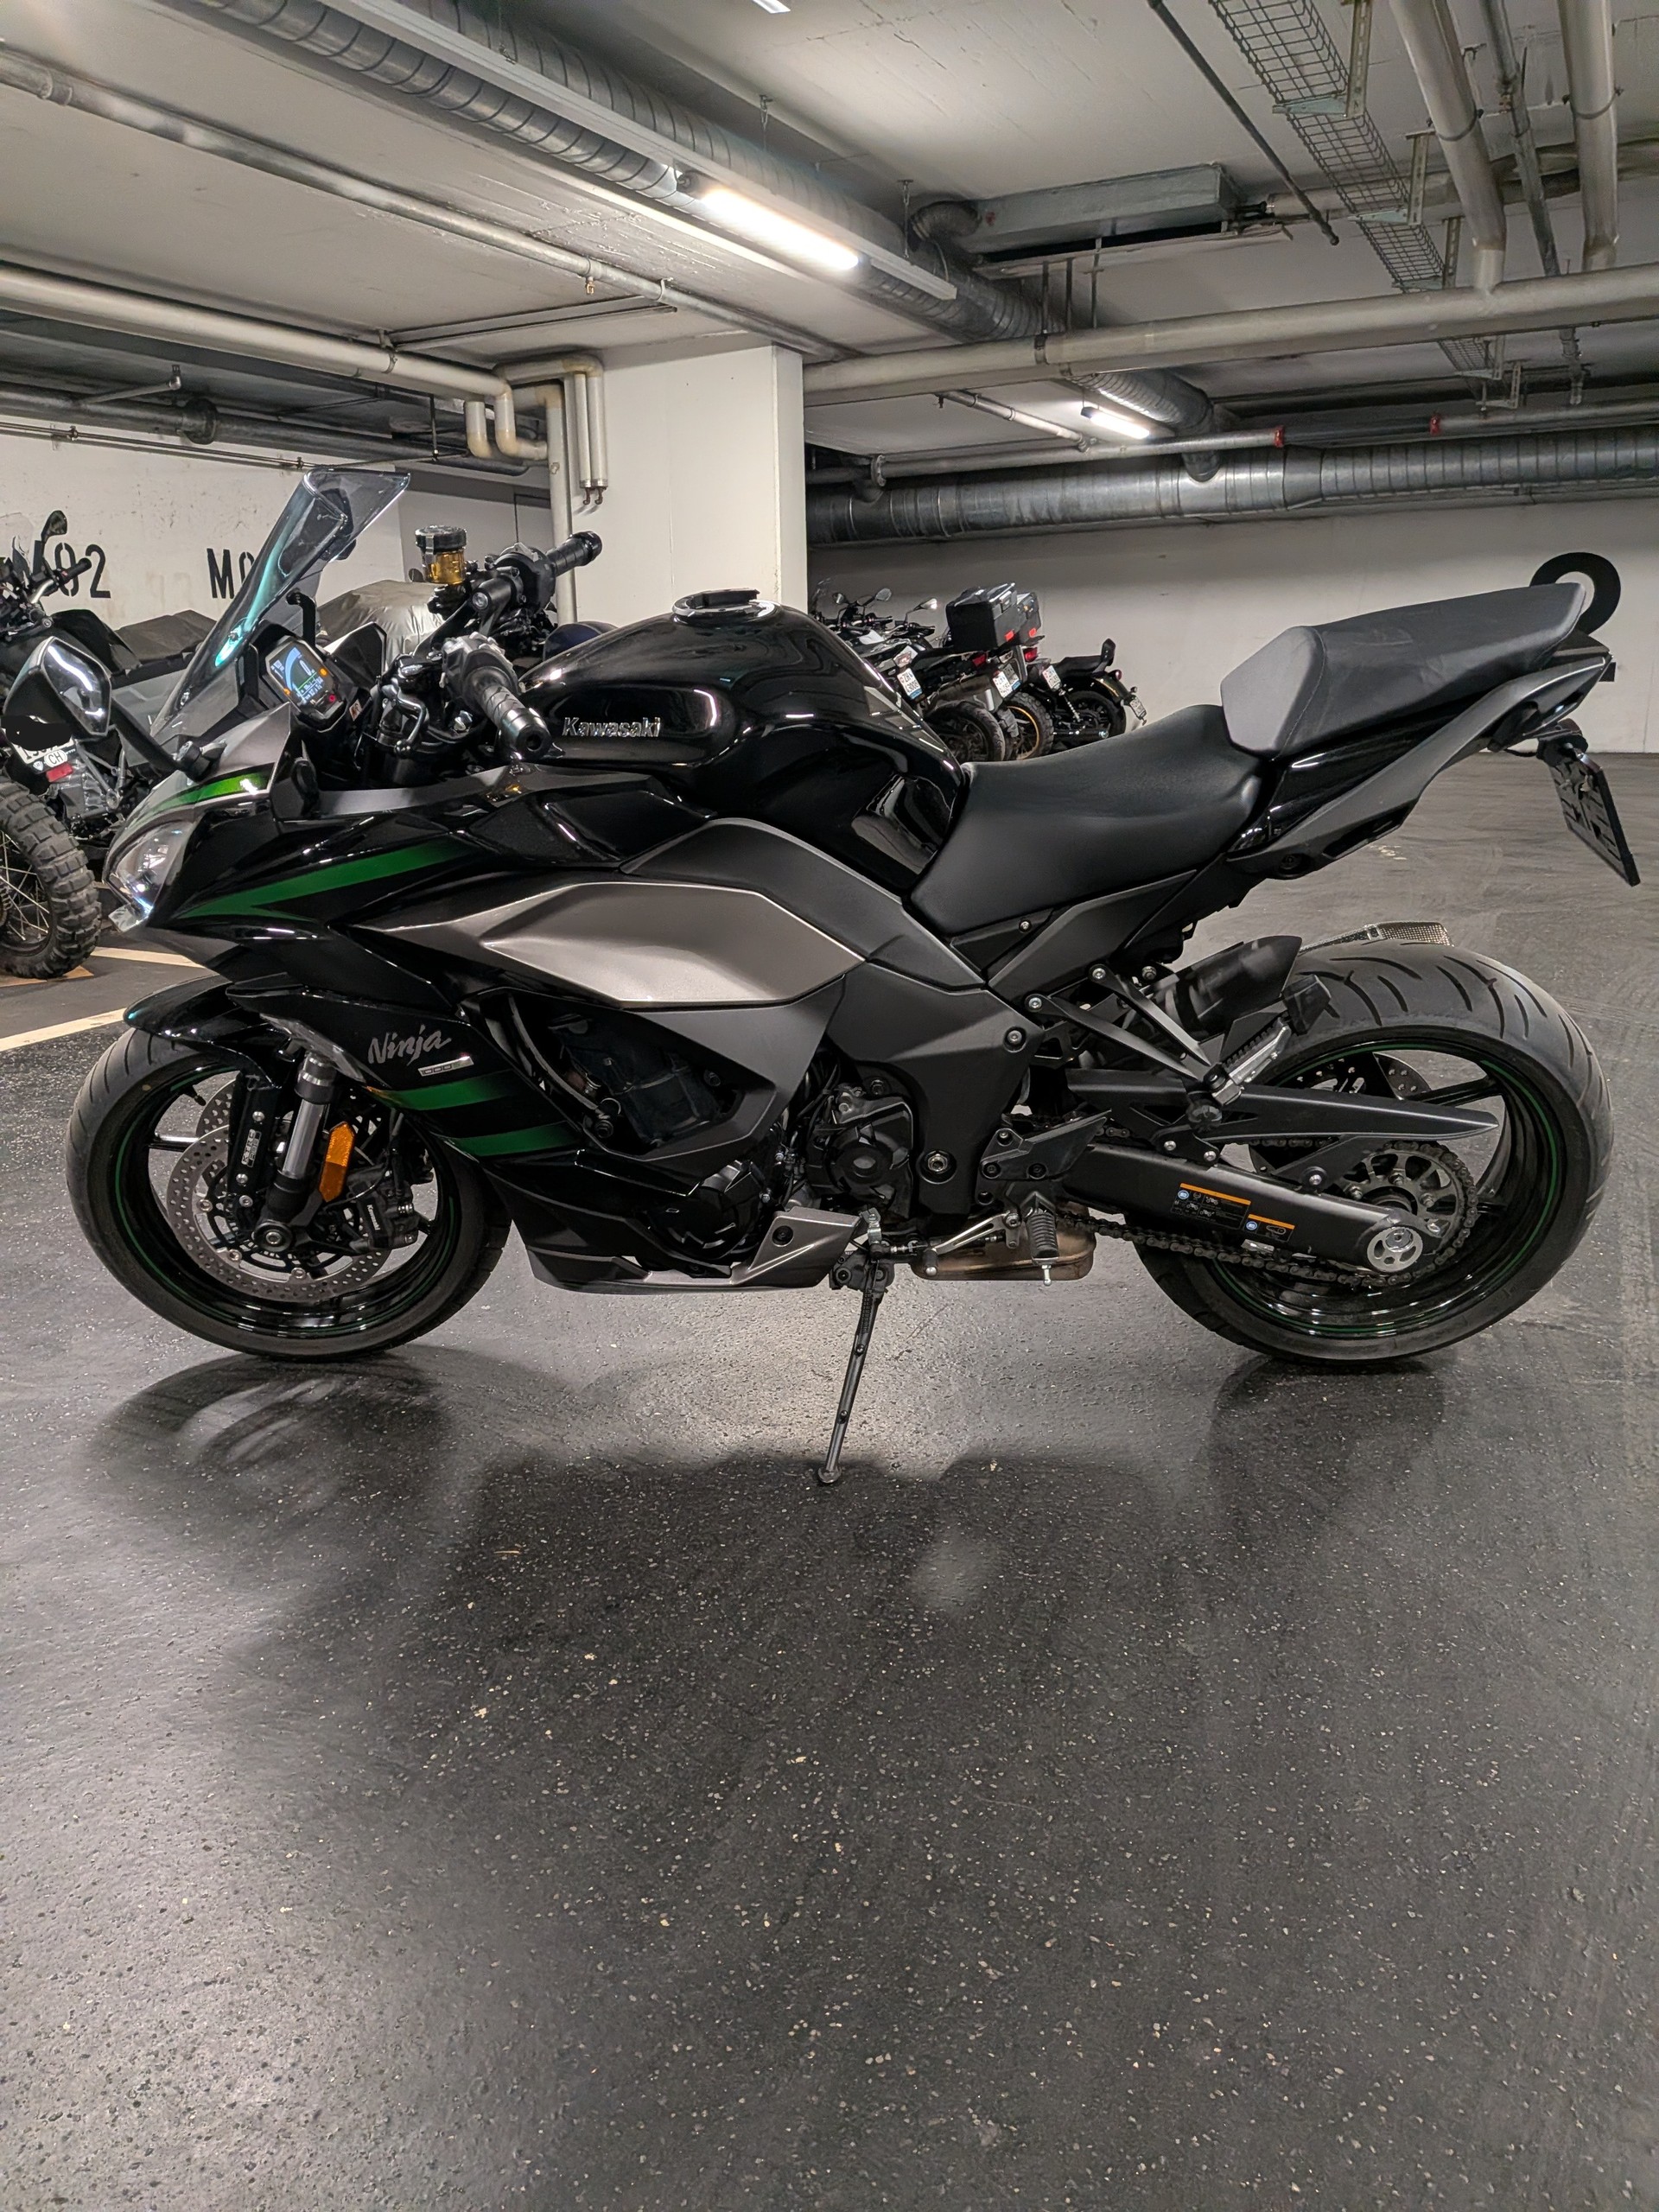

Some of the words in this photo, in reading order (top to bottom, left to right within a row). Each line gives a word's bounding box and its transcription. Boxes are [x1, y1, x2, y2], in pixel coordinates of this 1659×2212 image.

[562, 716, 661, 737] Kawasaki
[48, 752, 63, 765] CH
[367, 1024, 452, 1066] Ninja
